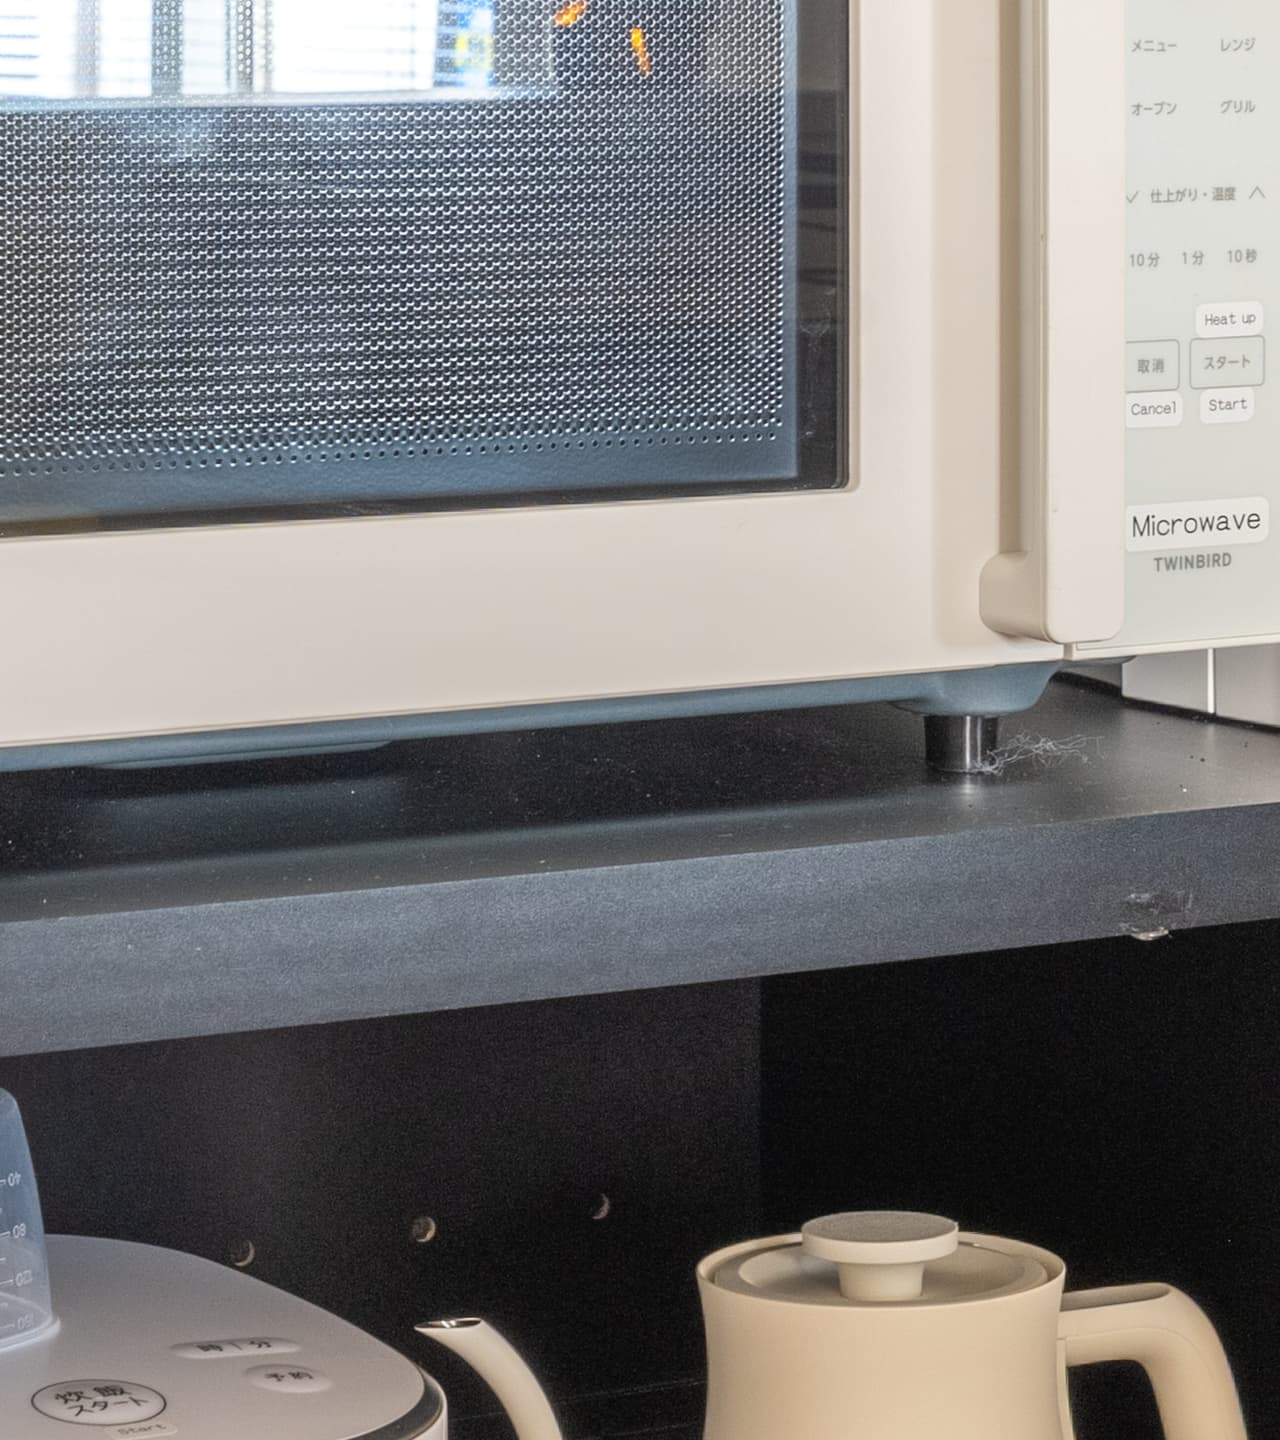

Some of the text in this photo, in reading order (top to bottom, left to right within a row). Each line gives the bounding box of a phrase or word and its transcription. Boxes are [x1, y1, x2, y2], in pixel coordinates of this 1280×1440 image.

[1131, 36, 1256, 53] メニュー レンジ
[1220, 98, 1256, 114] グリル
[1128, 248, 1258, 268] 10分 1分 10秒
[1204, 312, 1257, 327] Heat up
[1136, 354, 1252, 374] 取消 スタート
[1130, 400, 1178, 417] Cancel
[1208, 396, 1248, 412] Start
[1131, 509, 1262, 539] Microwave
[1154, 551, 1233, 572] TWINBIRD
[66, 1396, 150, 1417] スタート
